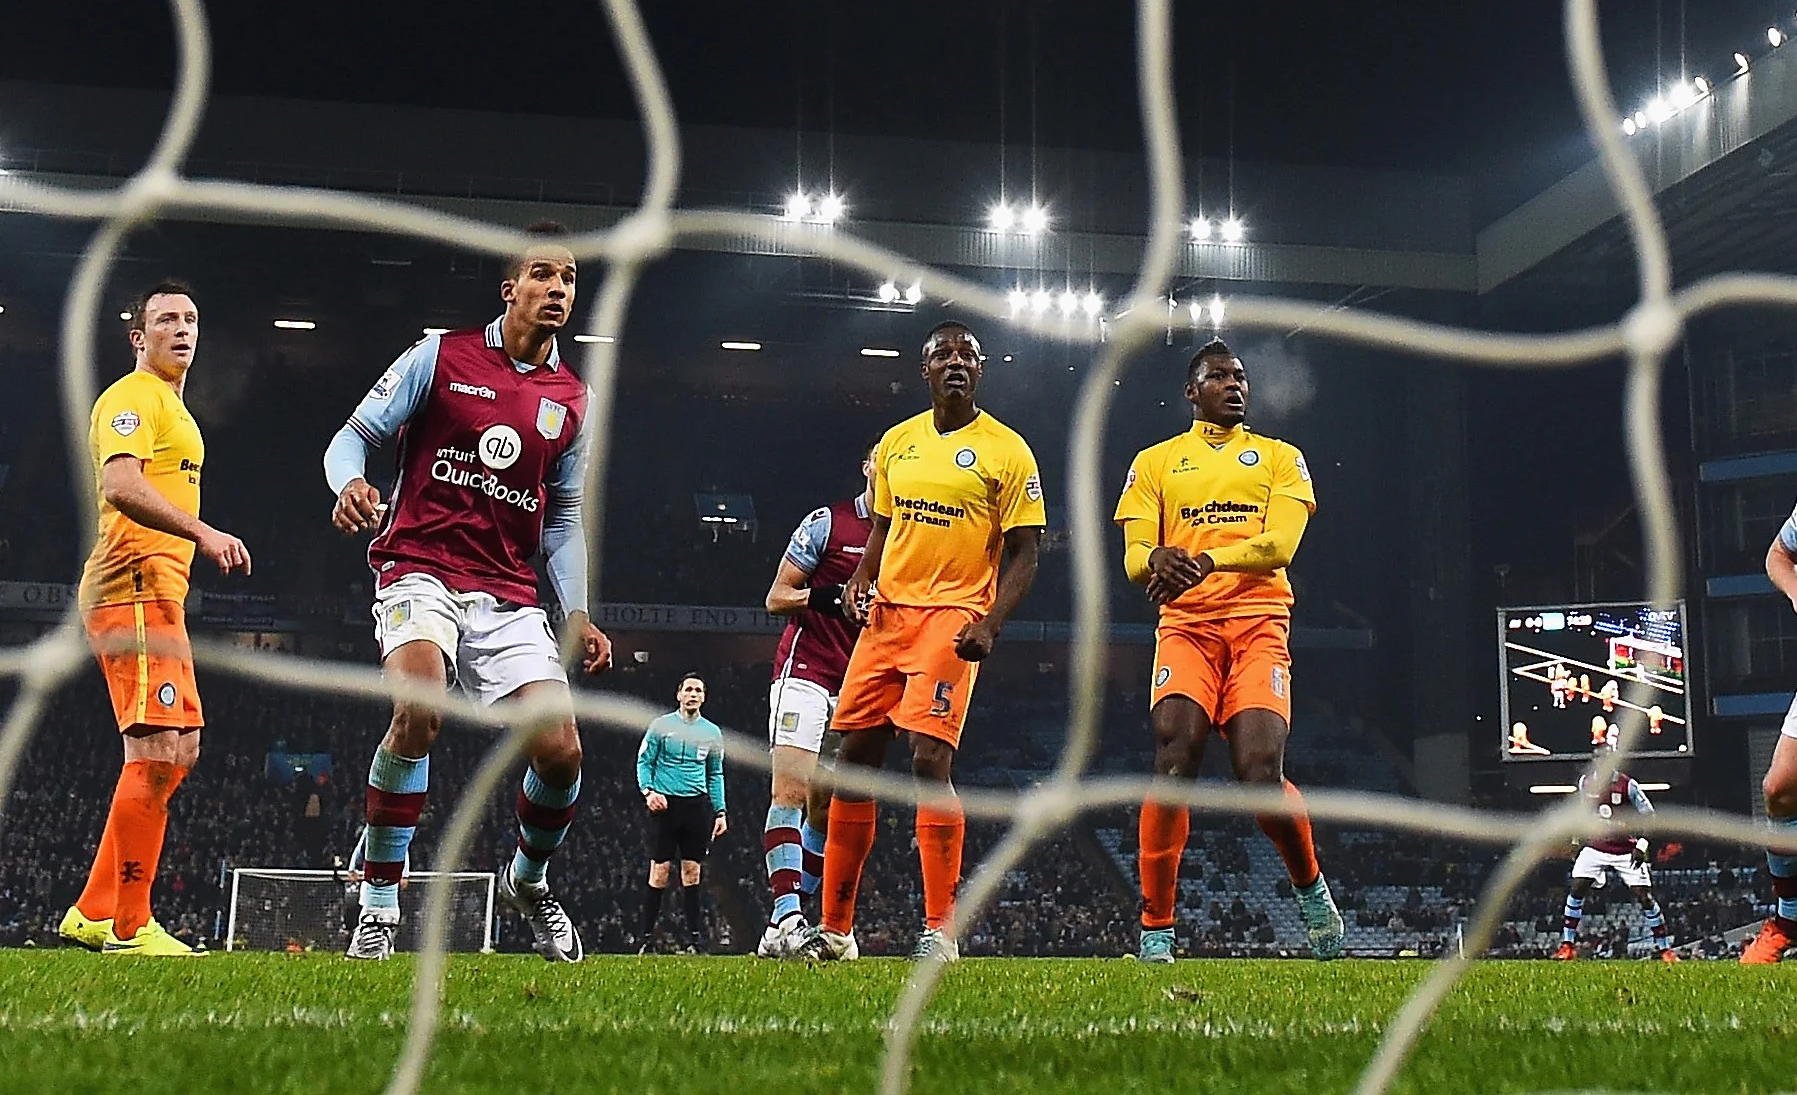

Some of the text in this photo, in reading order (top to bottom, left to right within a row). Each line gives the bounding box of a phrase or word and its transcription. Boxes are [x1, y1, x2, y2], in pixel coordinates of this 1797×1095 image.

[436, 446, 477, 464] intuit
[431, 460, 540, 513] QuickBooks
[913, 511, 951, 528] Cream
[1207, 514, 1248, 524] Cream
[604, 606, 677, 624] HOLTE
[690, 609, 738, 626] END
[929, 680, 954, 717] 5
